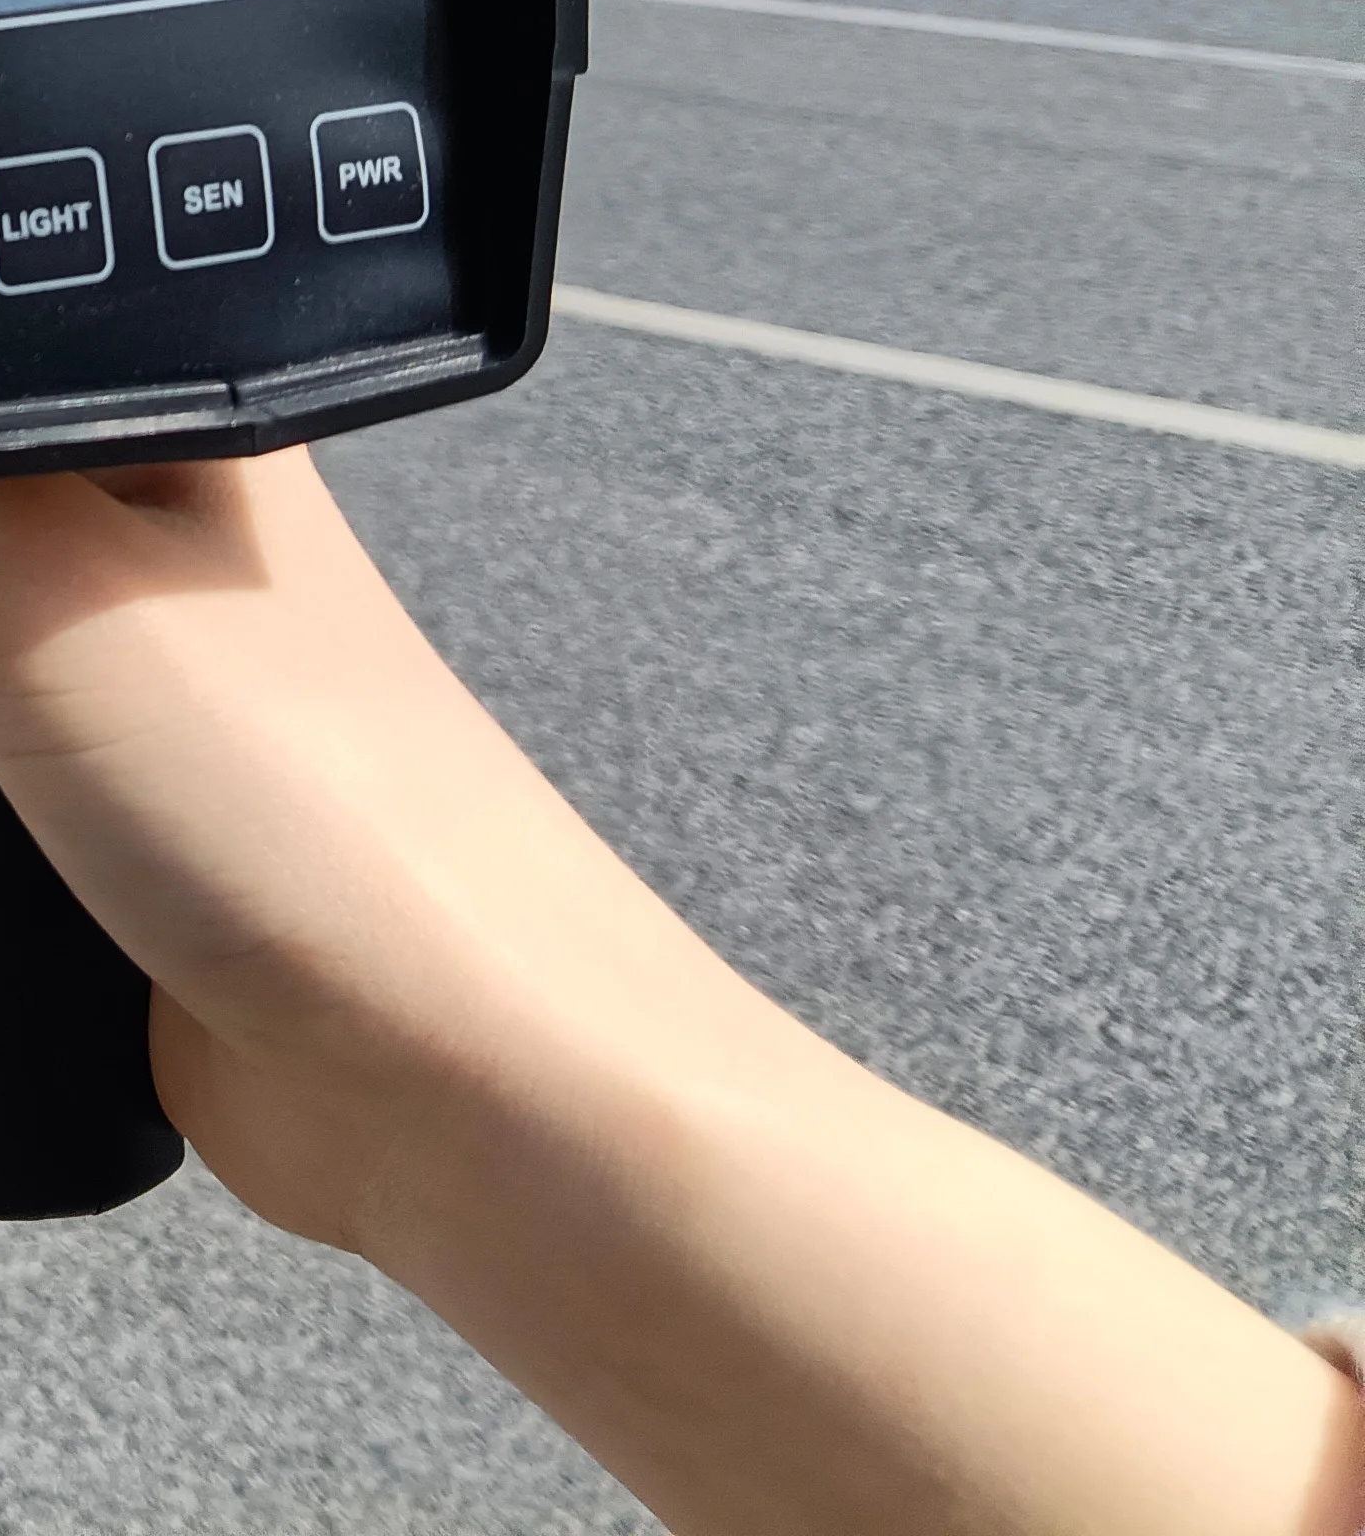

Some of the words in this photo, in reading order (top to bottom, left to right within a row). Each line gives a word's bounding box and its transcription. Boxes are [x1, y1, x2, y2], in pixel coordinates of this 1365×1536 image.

[338, 154, 403, 192] PWR
[182, 178, 245, 216] SEN
[1, 200, 93, 243] LIGHT
